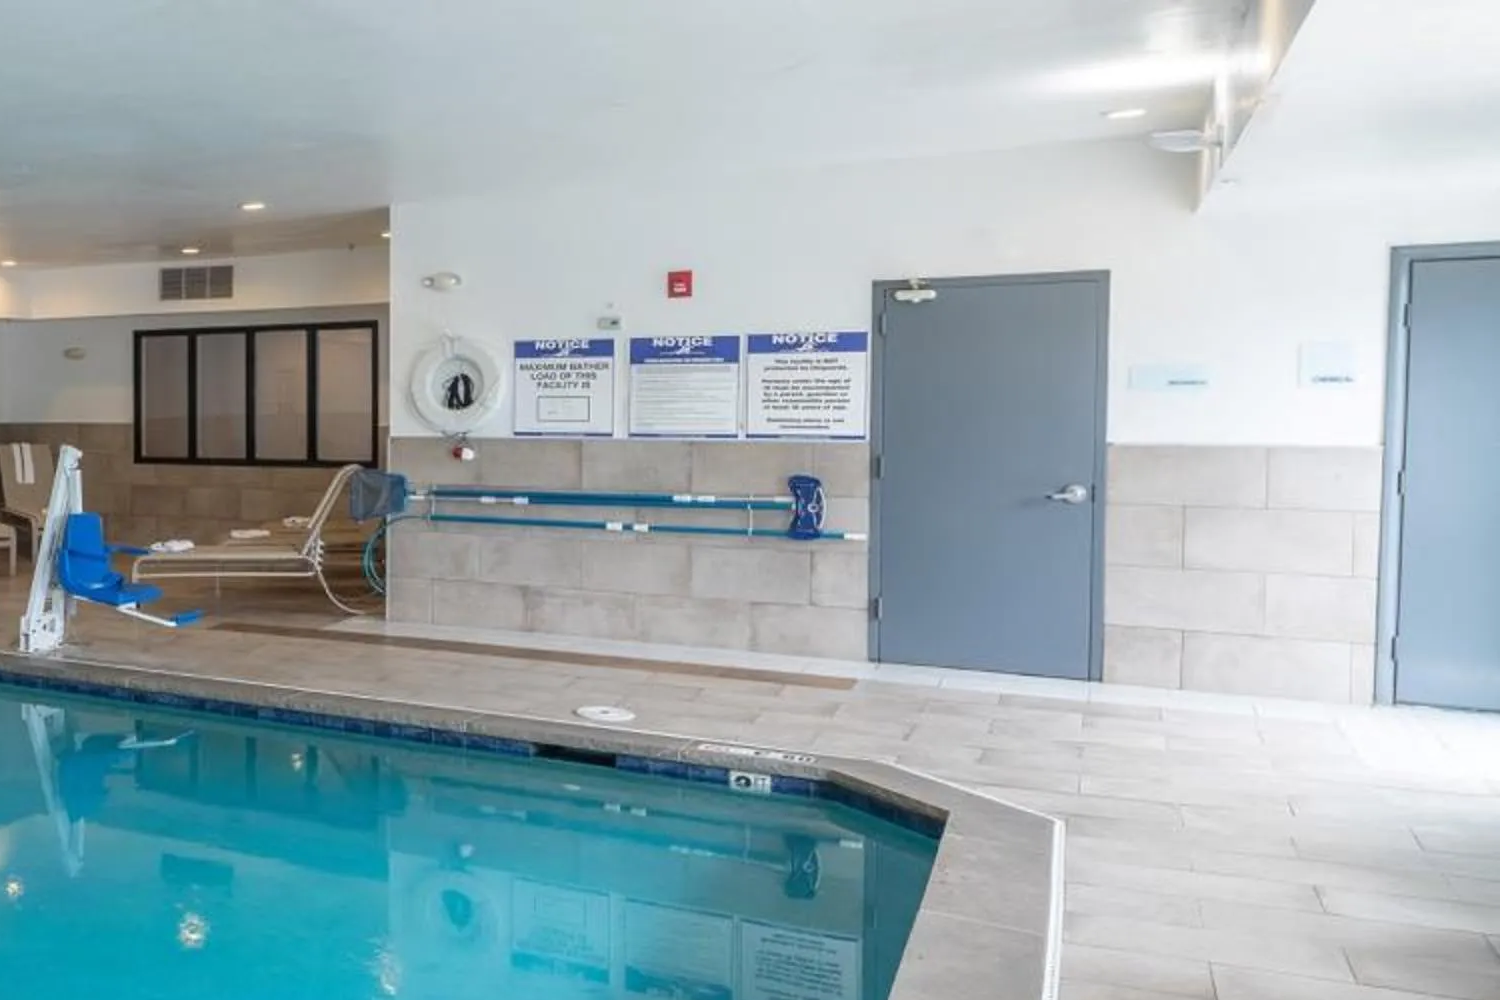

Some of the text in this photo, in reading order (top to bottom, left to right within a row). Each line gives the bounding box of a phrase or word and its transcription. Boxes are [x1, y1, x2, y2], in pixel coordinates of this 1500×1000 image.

[652, 336, 713, 347] NOTICE
[771, 333, 838, 344] NOTICE
[534, 339, 590, 350] NOTICE
[519, 362, 610, 371] MAXIMUM BATHER
[530, 372, 597, 380] LOAD OF THIS
[536, 381, 579, 389] FACILITY
